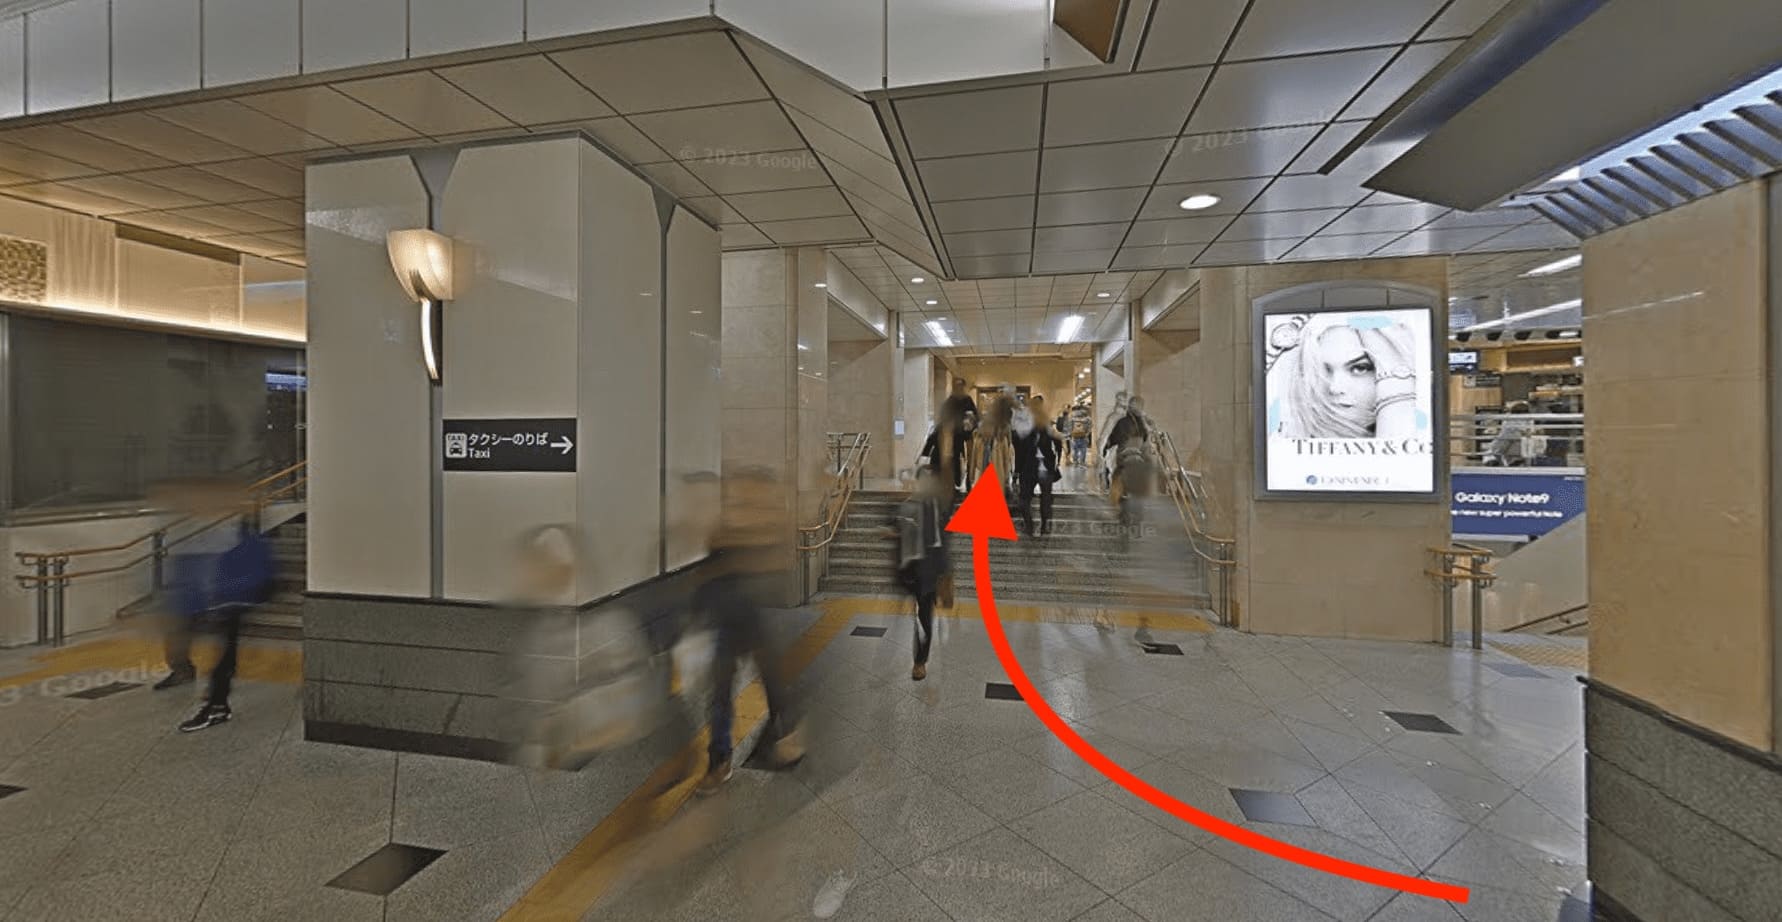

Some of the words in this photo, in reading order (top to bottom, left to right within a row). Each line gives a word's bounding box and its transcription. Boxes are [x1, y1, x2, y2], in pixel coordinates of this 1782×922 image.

[468, 432, 549, 446] タクシーのりば
[468, 447, 491, 458] Taxi
[1292, 439, 1379, 455] TIFFANY
[1454, 491, 1505, 505] Galaxy
[1507, 492, 1550, 504] Note9
